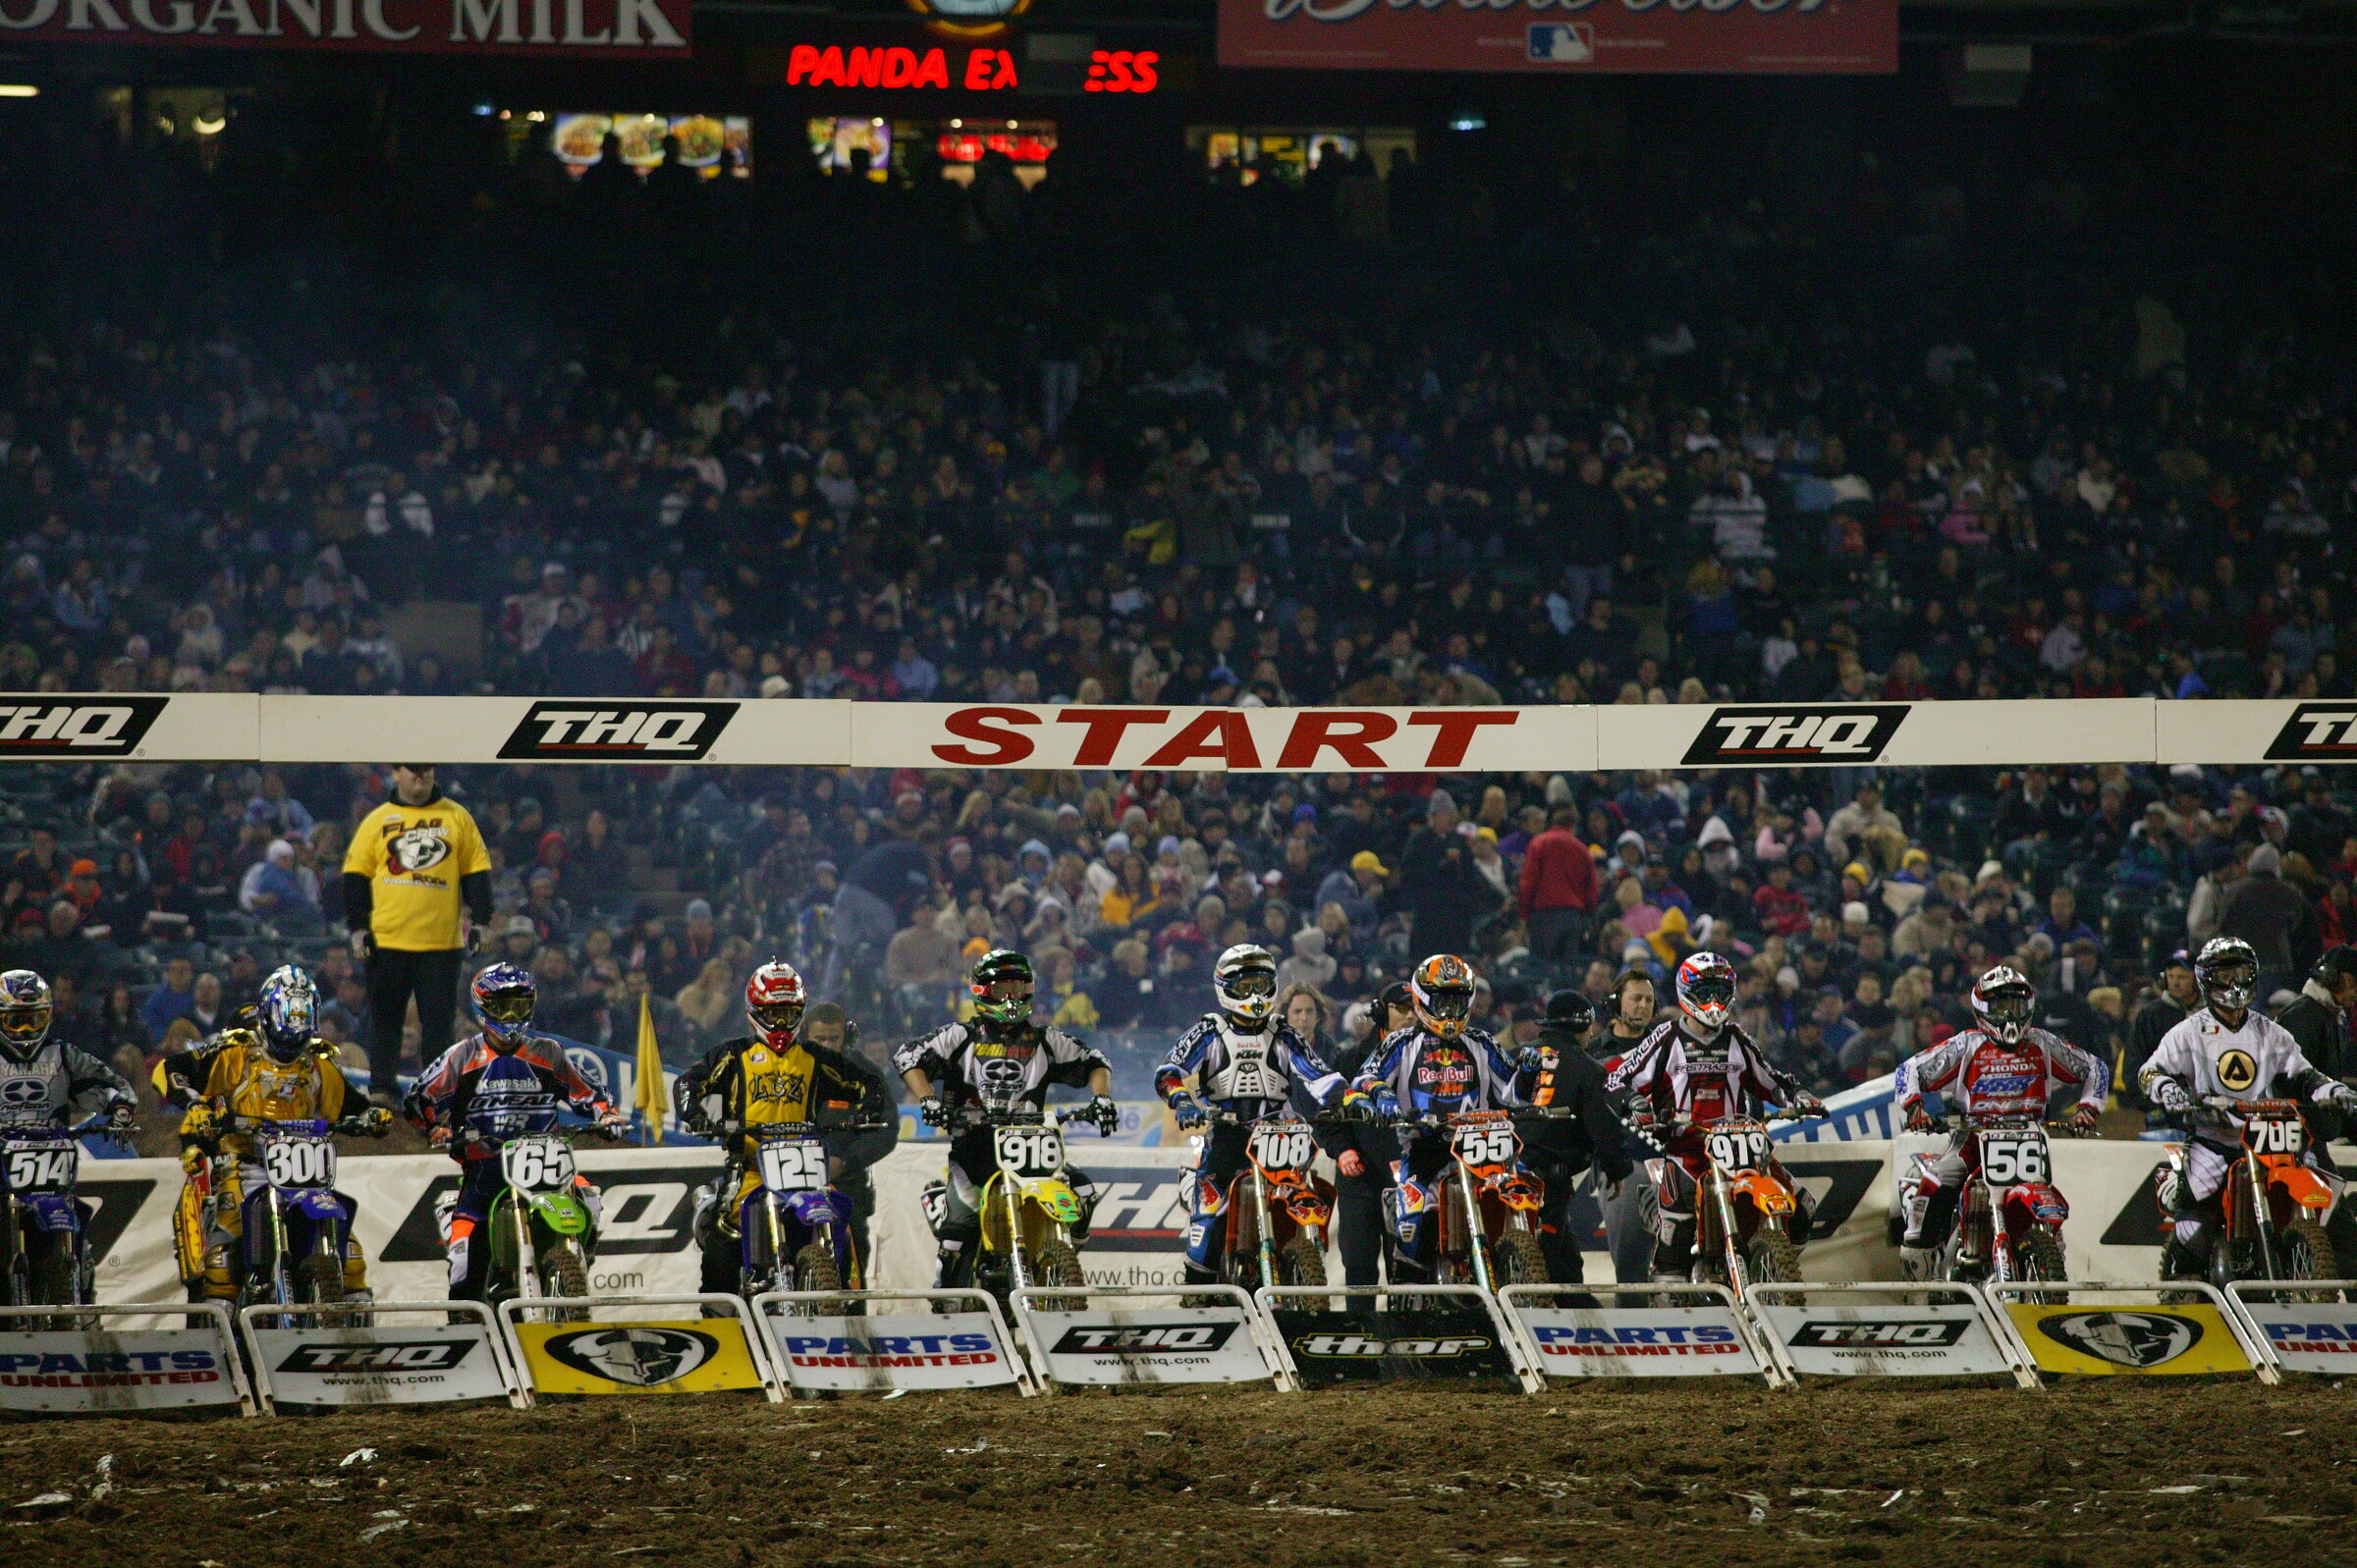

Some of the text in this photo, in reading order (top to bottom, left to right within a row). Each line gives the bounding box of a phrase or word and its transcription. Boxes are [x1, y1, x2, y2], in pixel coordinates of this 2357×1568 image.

[448, 0, 687, 46] MILK
[788, 45, 1159, 92] PANDA EXESS
[534, 709, 703, 751] THQ
[931, 707, 1520, 768] START
[1714, 714, 1881, 754] THQ
[405, 827, 449, 842] CREW
[1418, 1064, 1473, 1084] Red Bull
[1990, 1063, 2037, 1072] HONDA
[478, 1078, 541, 1090] Kawasaki
[1462, 1130, 1513, 1164] 55
[2249, 1120, 2302, 1153] 706
[1003, 1135, 1063, 1170] 918
[1253, 1133, 1311, 1168] 108
[1711, 1132, 1769, 1169] 979
[1986, 1141, 2047, 1182] 56
[10, 1151, 75, 1188] 514
[267, 1142, 334, 1185] 300
[512, 1139, 575, 1188] 65
[763, 1147, 827, 1190] 125
[786, 1332, 993, 1354] PARTS
[1073, 1326, 1215, 1350] THQ
[1303, 1333, 1489, 1356] thor
[1533, 1325, 1734, 1343] PARTS
[1811, 1324, 1948, 1344] THQ
[303, 1344, 453, 1368] THQ
[792, 1353, 999, 1368] UNLIMITED
[1093, 1354, 1211, 1368] www.thq.com
[1543, 1344, 1741, 1355] UNLIMITED
[1833, 1349, 1947, 1361] www.thq.com
[1, 1350, 217, 1374] PARTS
[2, 1371, 220, 1387] UNLIMITED
[322, 1373, 446, 1387] www.thq.com
